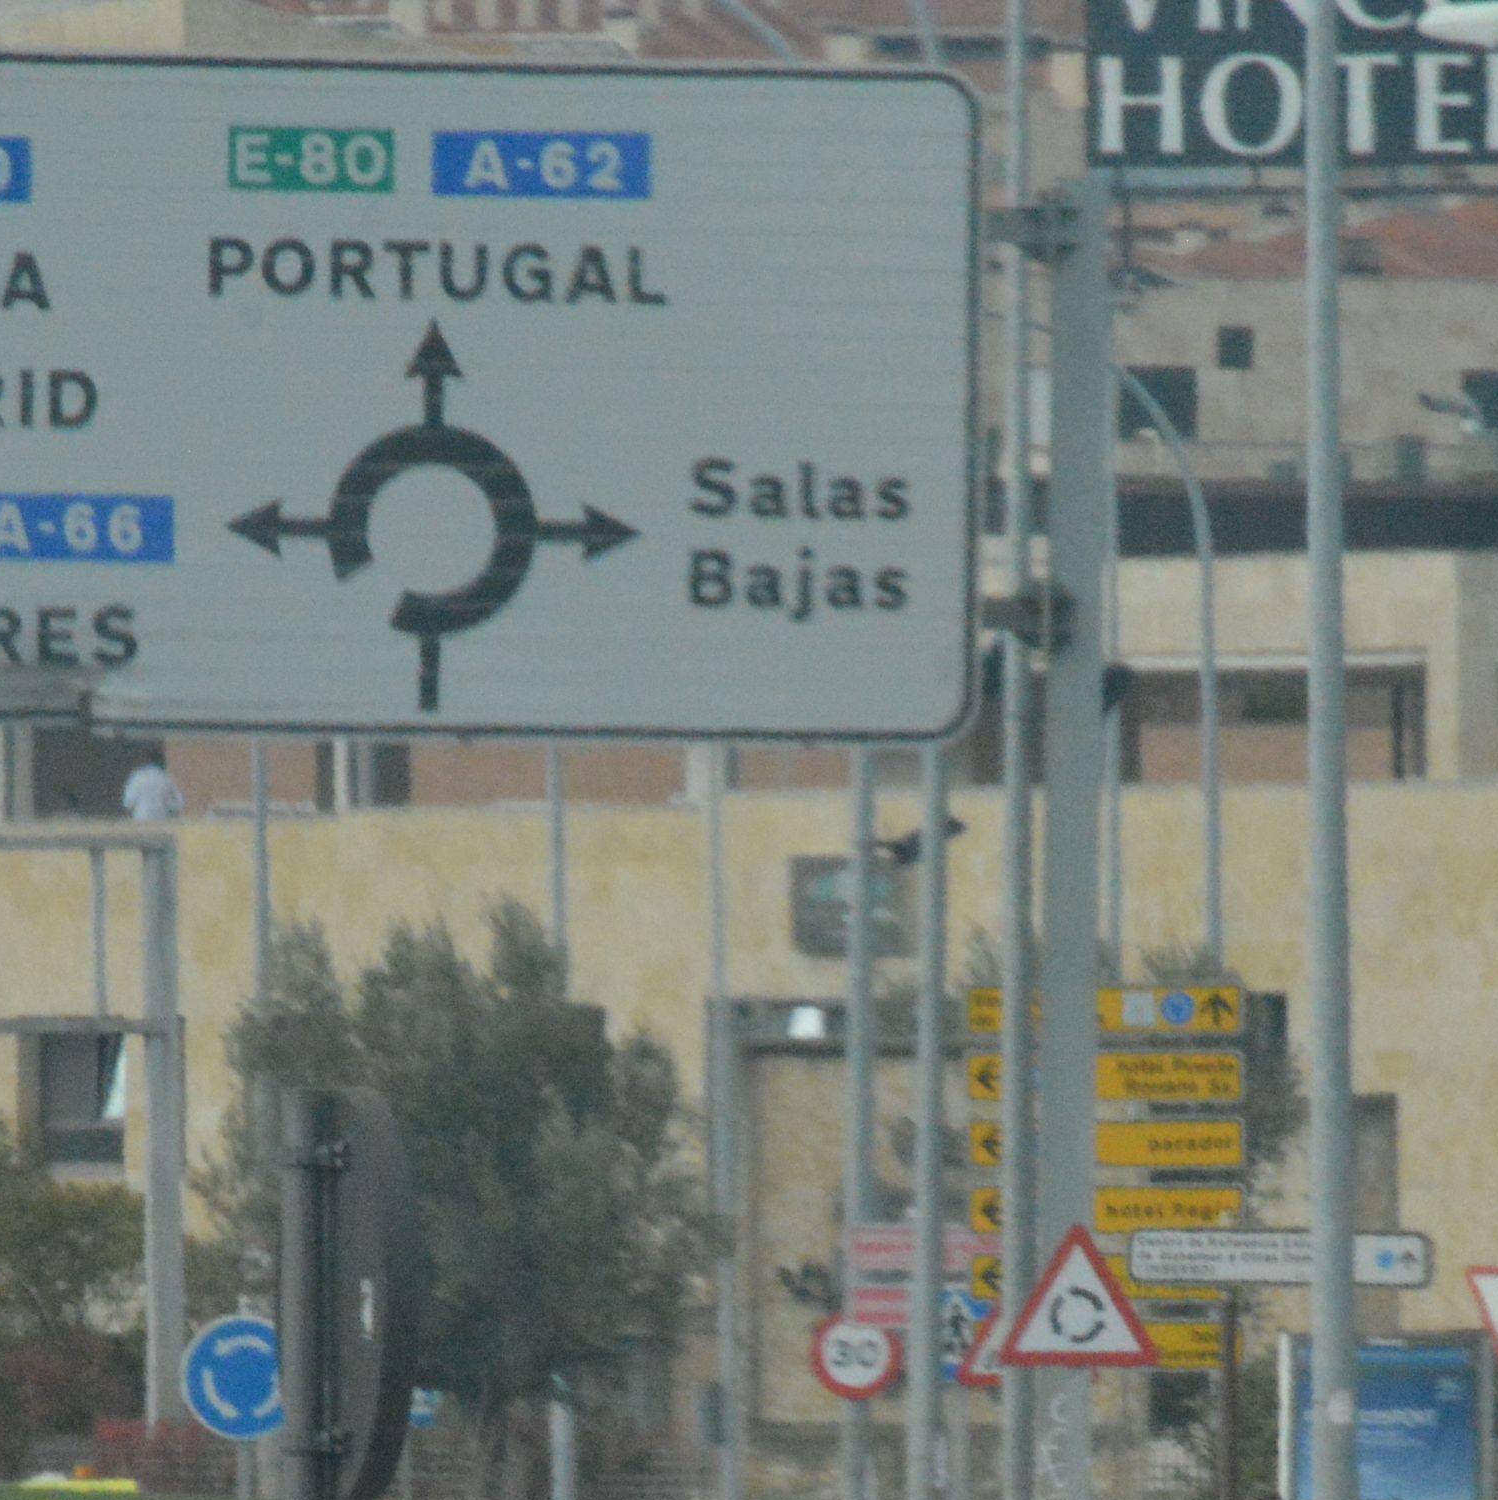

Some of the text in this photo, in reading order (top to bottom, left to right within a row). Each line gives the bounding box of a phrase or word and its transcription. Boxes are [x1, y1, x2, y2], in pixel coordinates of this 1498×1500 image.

[234, 131, 623, 192] E-80 A-62
[206, 236, 668, 306] PORTUGAL
[687, 456, 912, 522] Salas
[688, 547, 910, 621] Bajas
[1172, 1202, 1233, 1221] Regi
